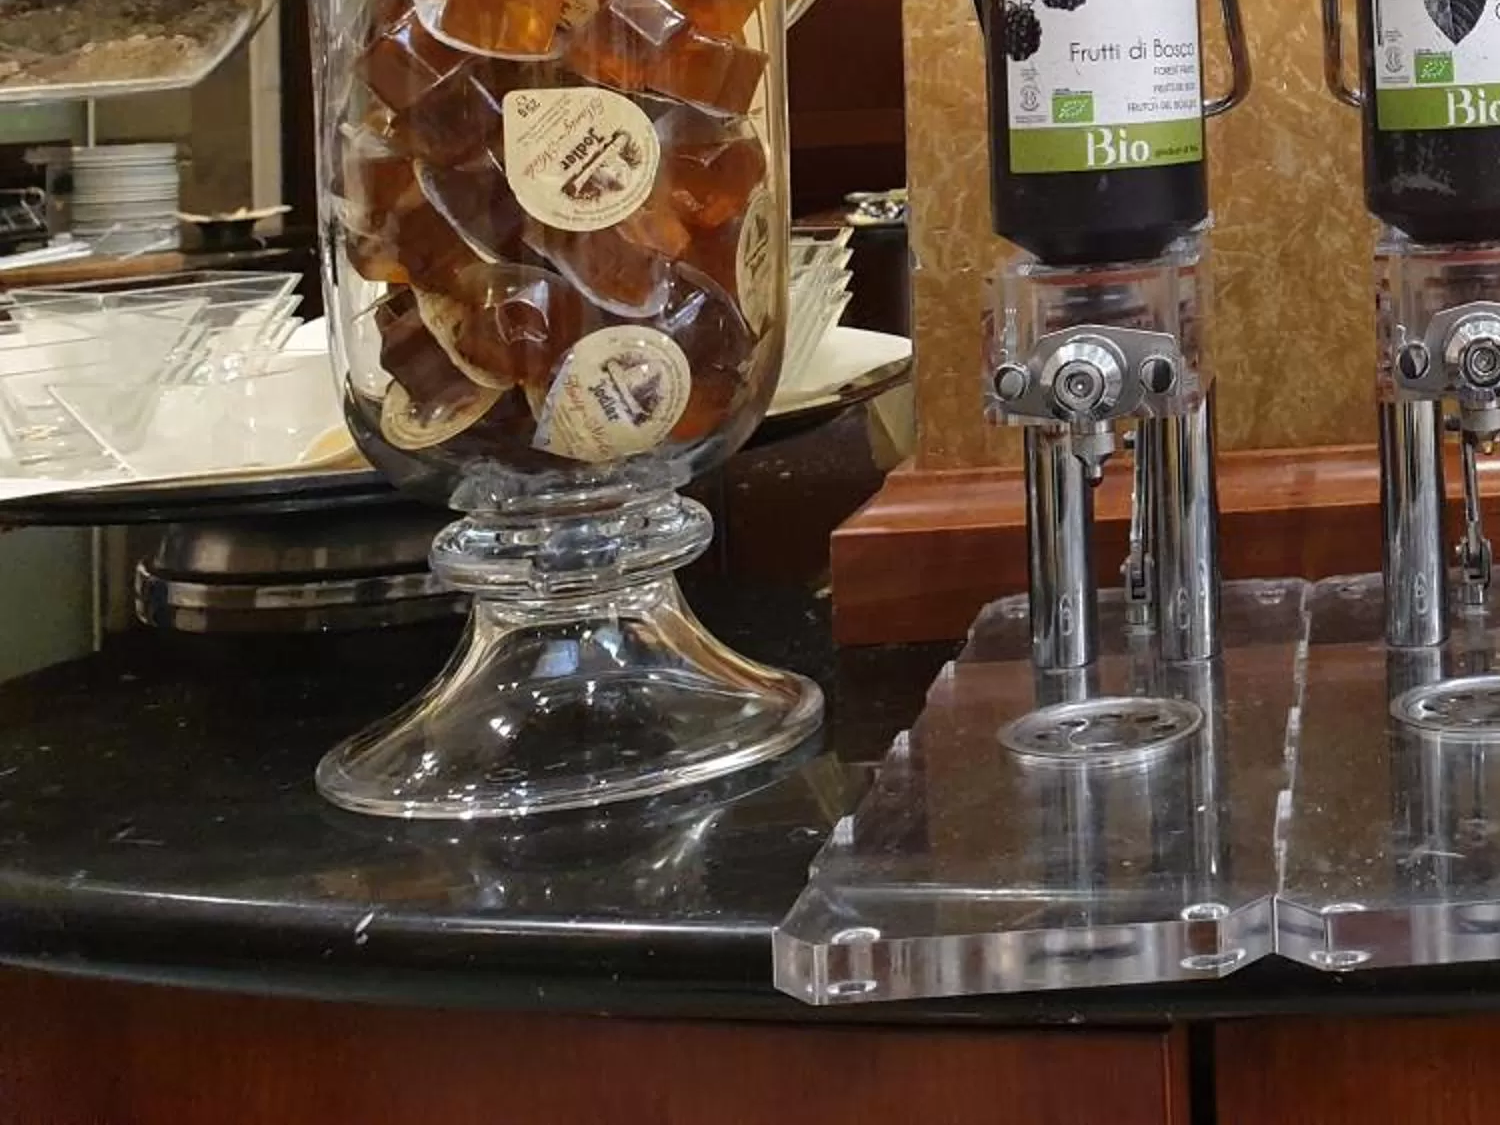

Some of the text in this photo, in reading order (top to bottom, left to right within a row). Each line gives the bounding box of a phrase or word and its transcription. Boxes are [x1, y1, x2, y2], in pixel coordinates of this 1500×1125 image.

[1068, 37, 1195, 62] Frutti di Bosco
[560, 127, 604, 171] Jodler
[1087, 128, 1150, 167] Bio
[588, 378, 619, 422] Jodler
